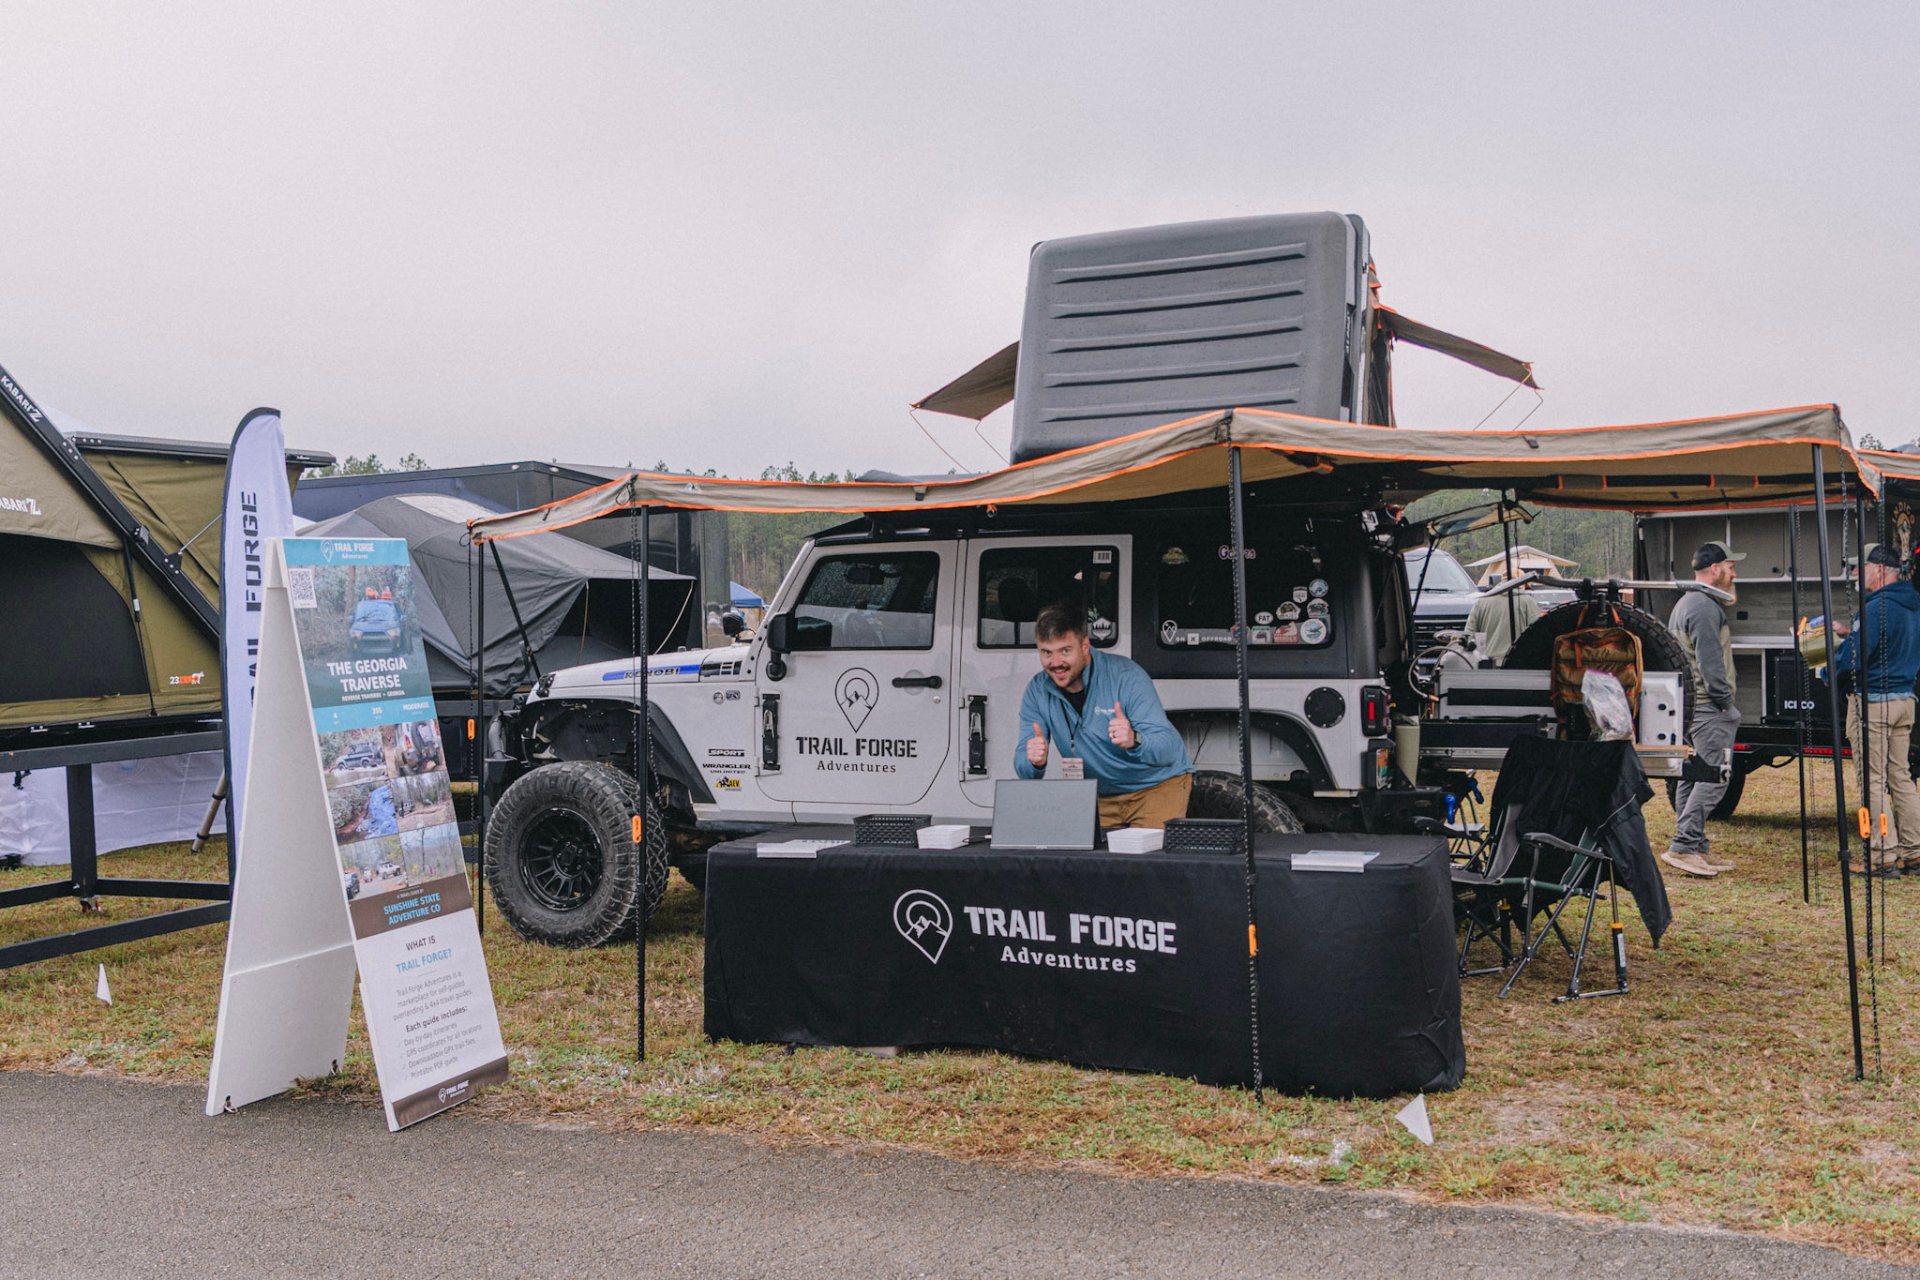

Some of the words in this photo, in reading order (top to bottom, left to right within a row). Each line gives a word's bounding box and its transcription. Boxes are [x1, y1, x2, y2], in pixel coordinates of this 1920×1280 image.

[241, 491, 262, 612] FORGE
[327, 661, 353, 676] THE
[355, 657, 408, 674] GEORGIA
[340, 674, 402, 693] TRAVERSE
[709, 749, 744, 757] SPORT
[796, 736, 848, 756] TRAIL
[855, 738, 918, 758] FORGE
[817, 760, 897, 773] Adventures
[383, 898, 419, 914] SUNSHINE
[420, 892, 441, 905] STATE
[388, 906, 430, 925] ADVENTURE
[430, 904, 441, 913] CO
[963, 906, 1056, 942] TRAIL
[1069, 913, 1178, 955] FORGE
[405, 937, 427, 951] WHAT
[428, 935, 436, 944] IS
[395, 959, 420, 974] TRAIL
[421, 948, 453, 966] FORGE?
[1000, 945, 1137, 973] Adventures
[405, 1021, 421, 1033] Each
[422, 1016, 440, 1028] guide
[440, 1005, 468, 1020] includes:
